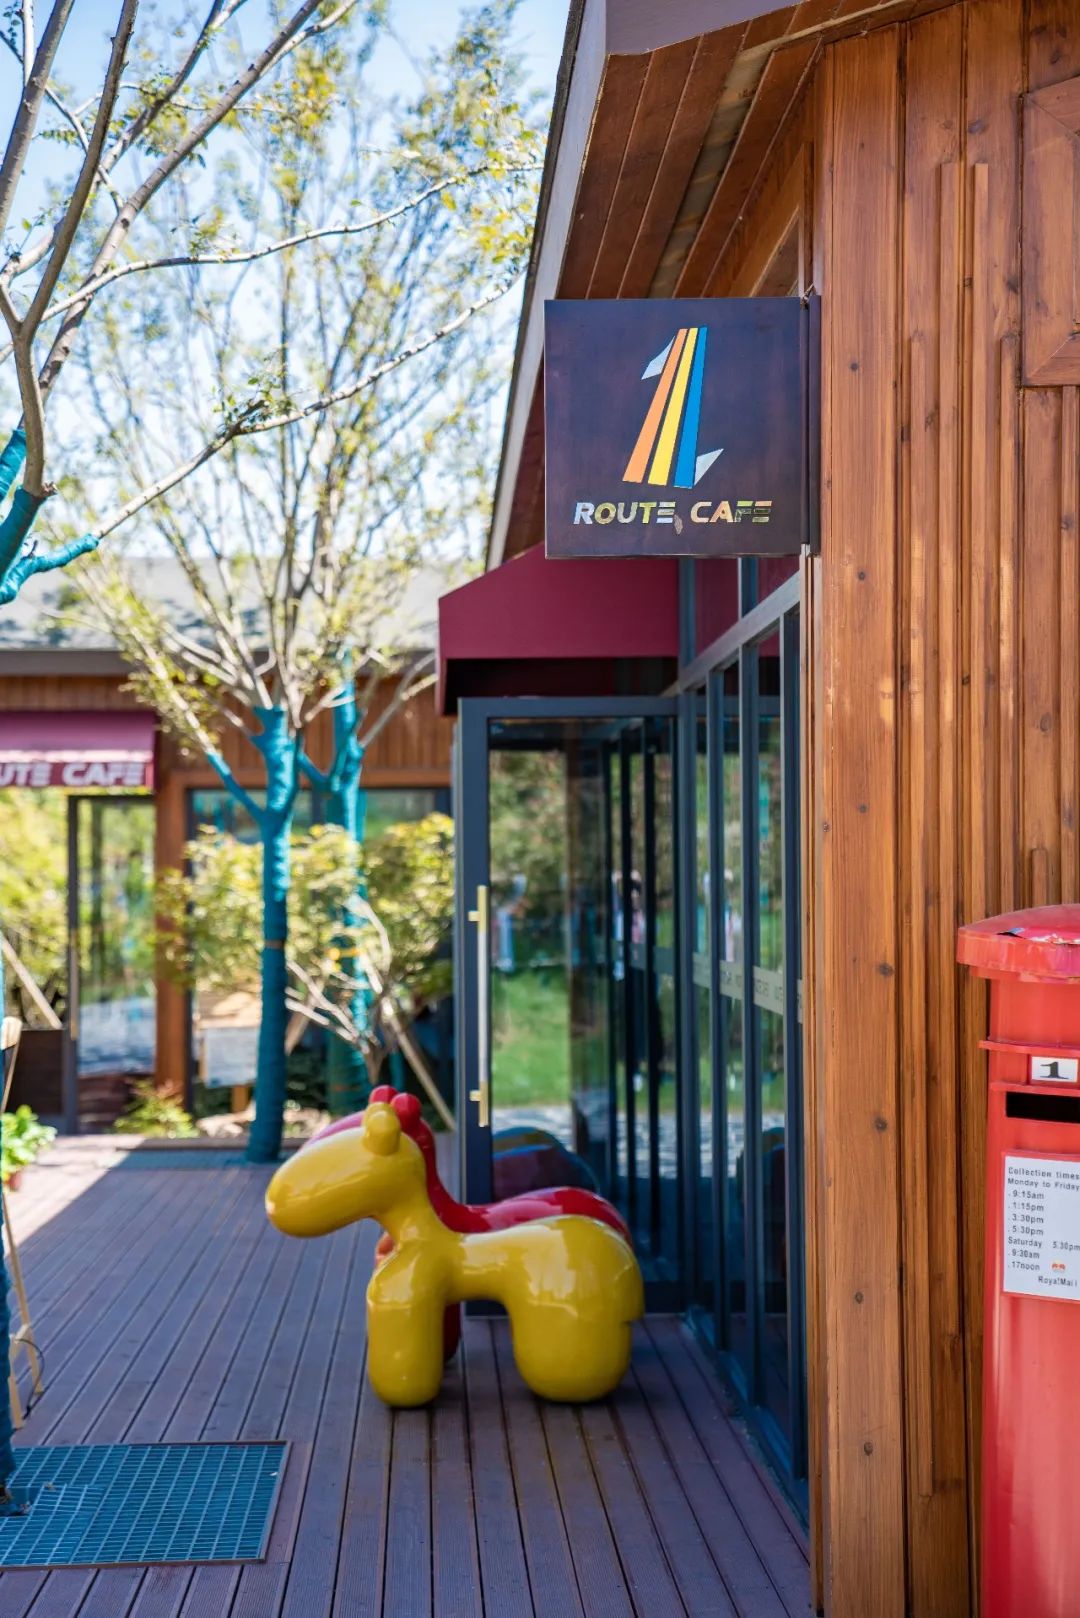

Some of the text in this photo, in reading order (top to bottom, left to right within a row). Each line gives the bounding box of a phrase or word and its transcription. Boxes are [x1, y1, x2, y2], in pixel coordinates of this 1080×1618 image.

[573, 500, 773, 525] ROUTE CAFE
[62, 762, 145, 786] CAFE
[1040, 1061, 1069, 1080] 1
[1008, 1167, 1080, 1180] Collection times
[1007, 1178, 1038, 1188] Monday
[1054, 1181, 1080, 1191] Friday
[1008, 1236, 1042, 1248] Saturday
